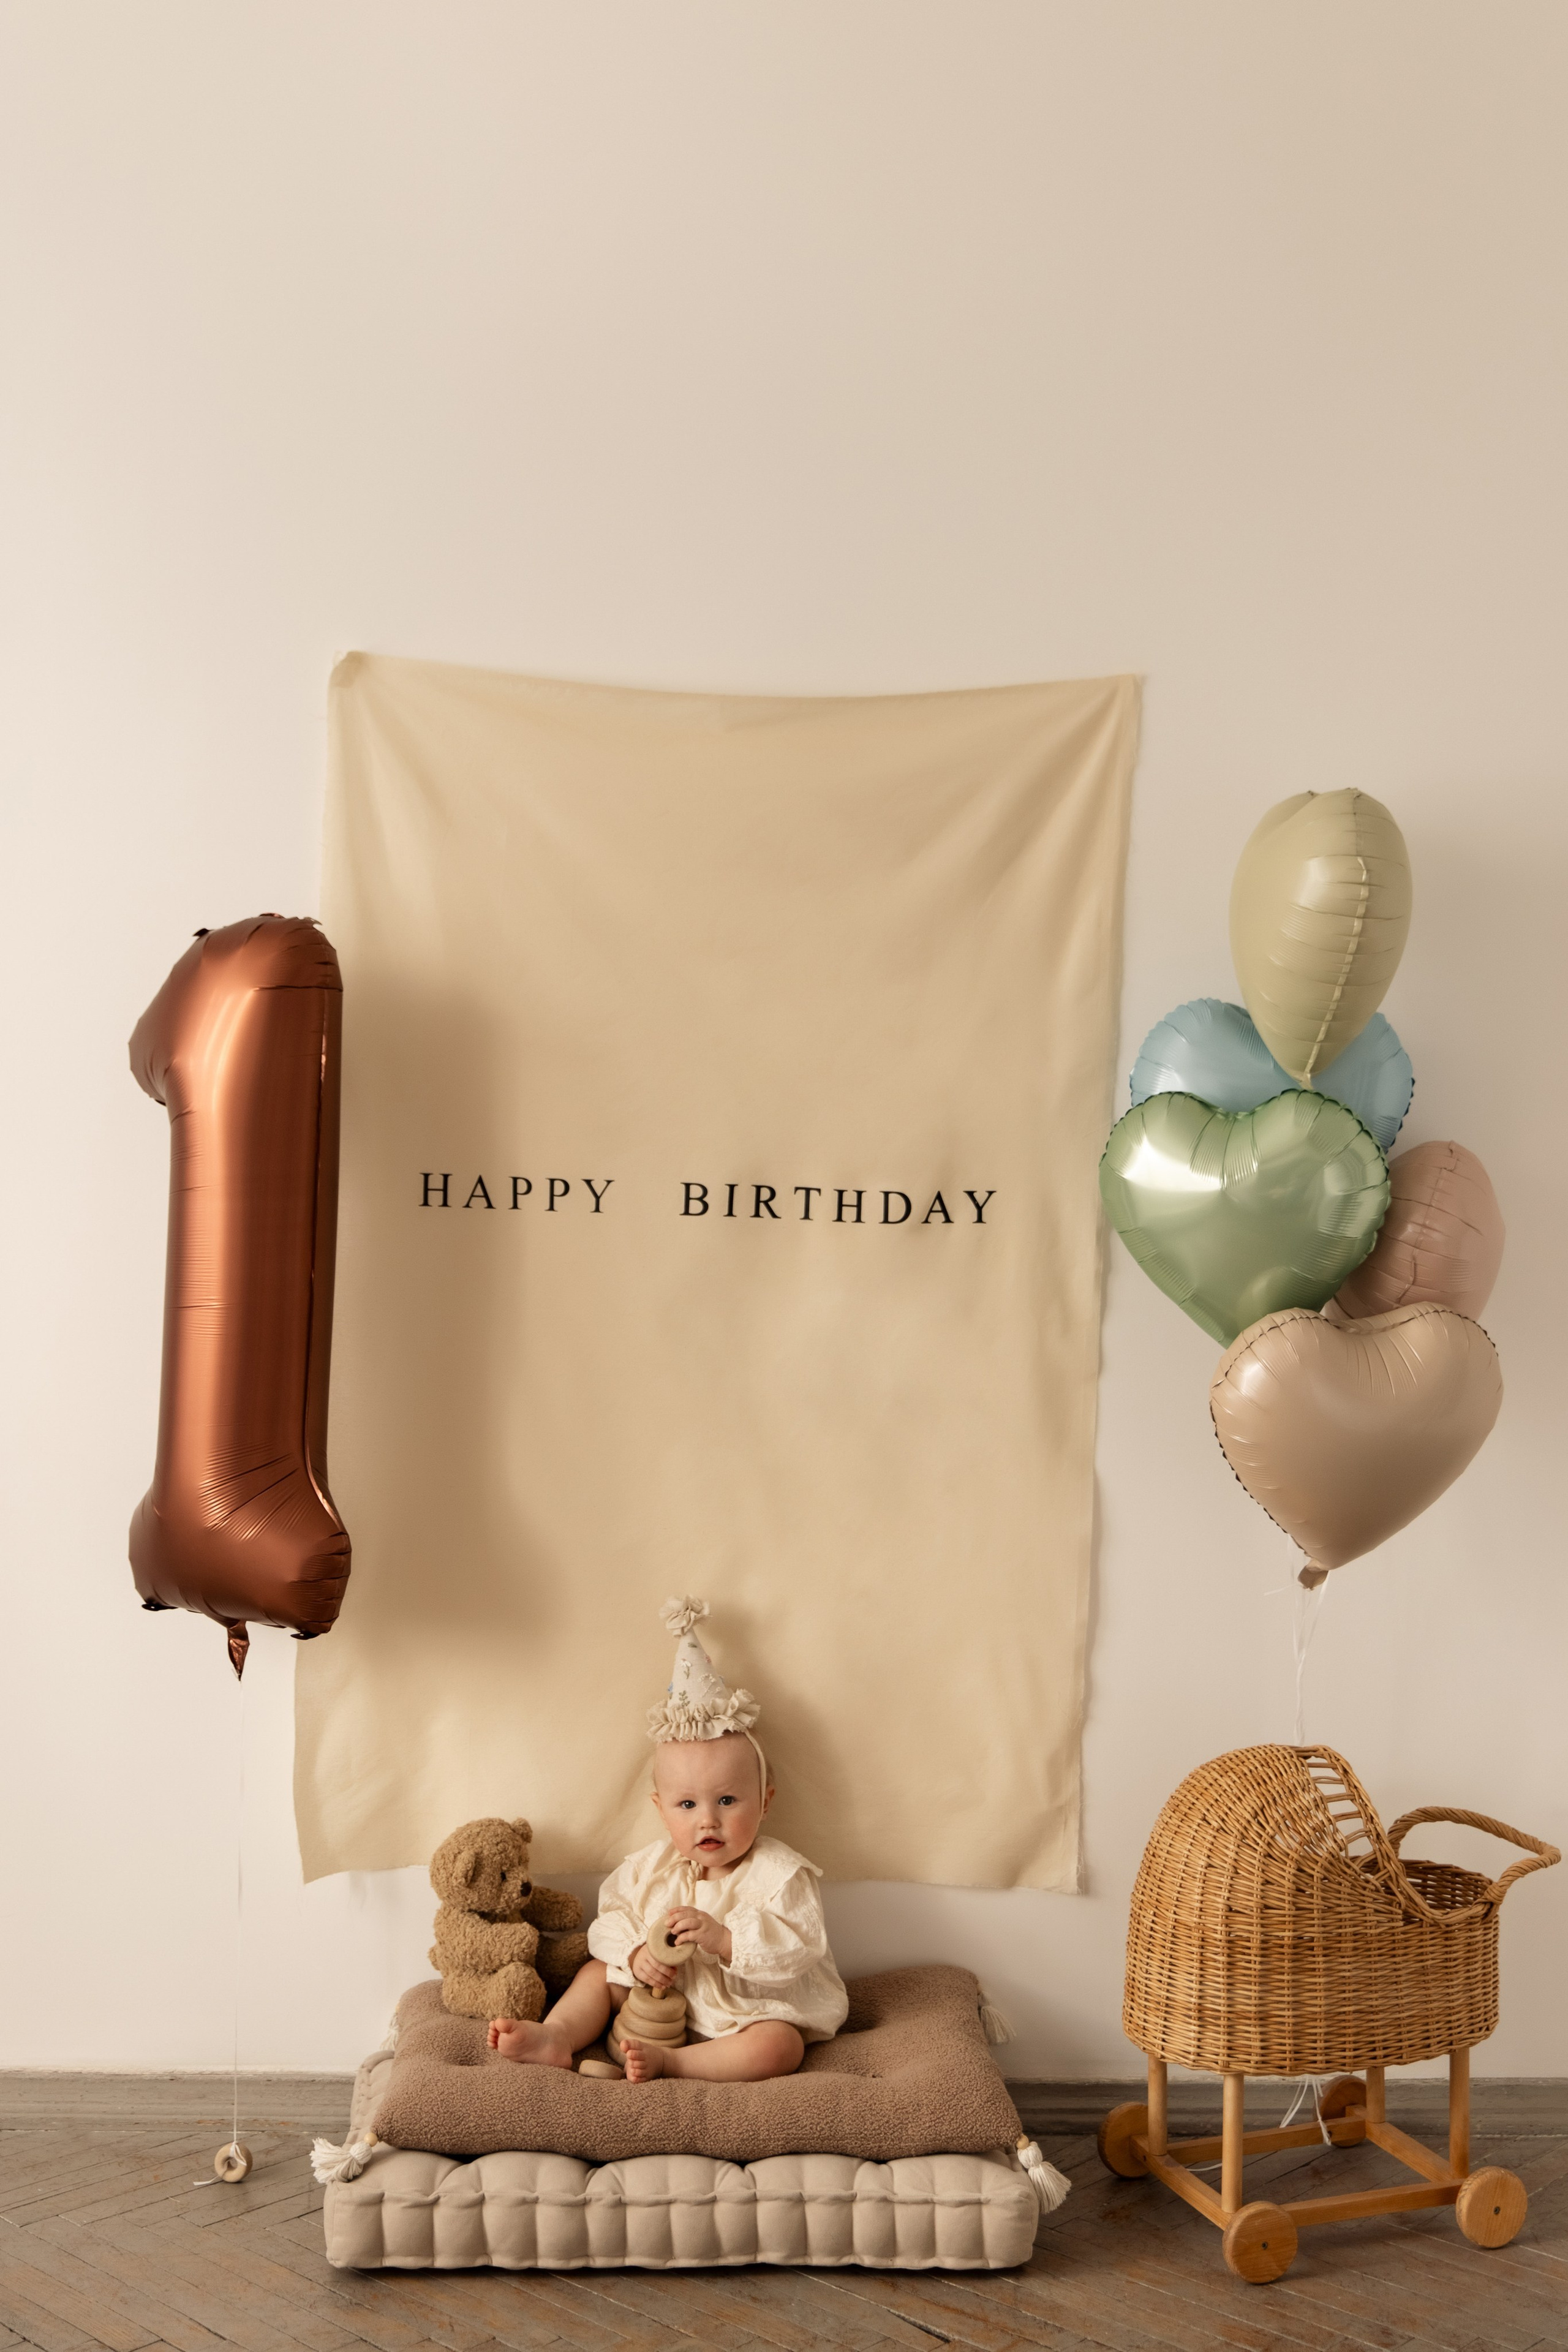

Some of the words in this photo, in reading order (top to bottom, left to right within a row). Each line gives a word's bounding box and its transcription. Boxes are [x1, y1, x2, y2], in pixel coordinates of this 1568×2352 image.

[129, 913, 351, 1640] 1
[418, 1172, 614, 1213] HAPPY
[680, 1182, 997, 1224] BIRTHDAY
